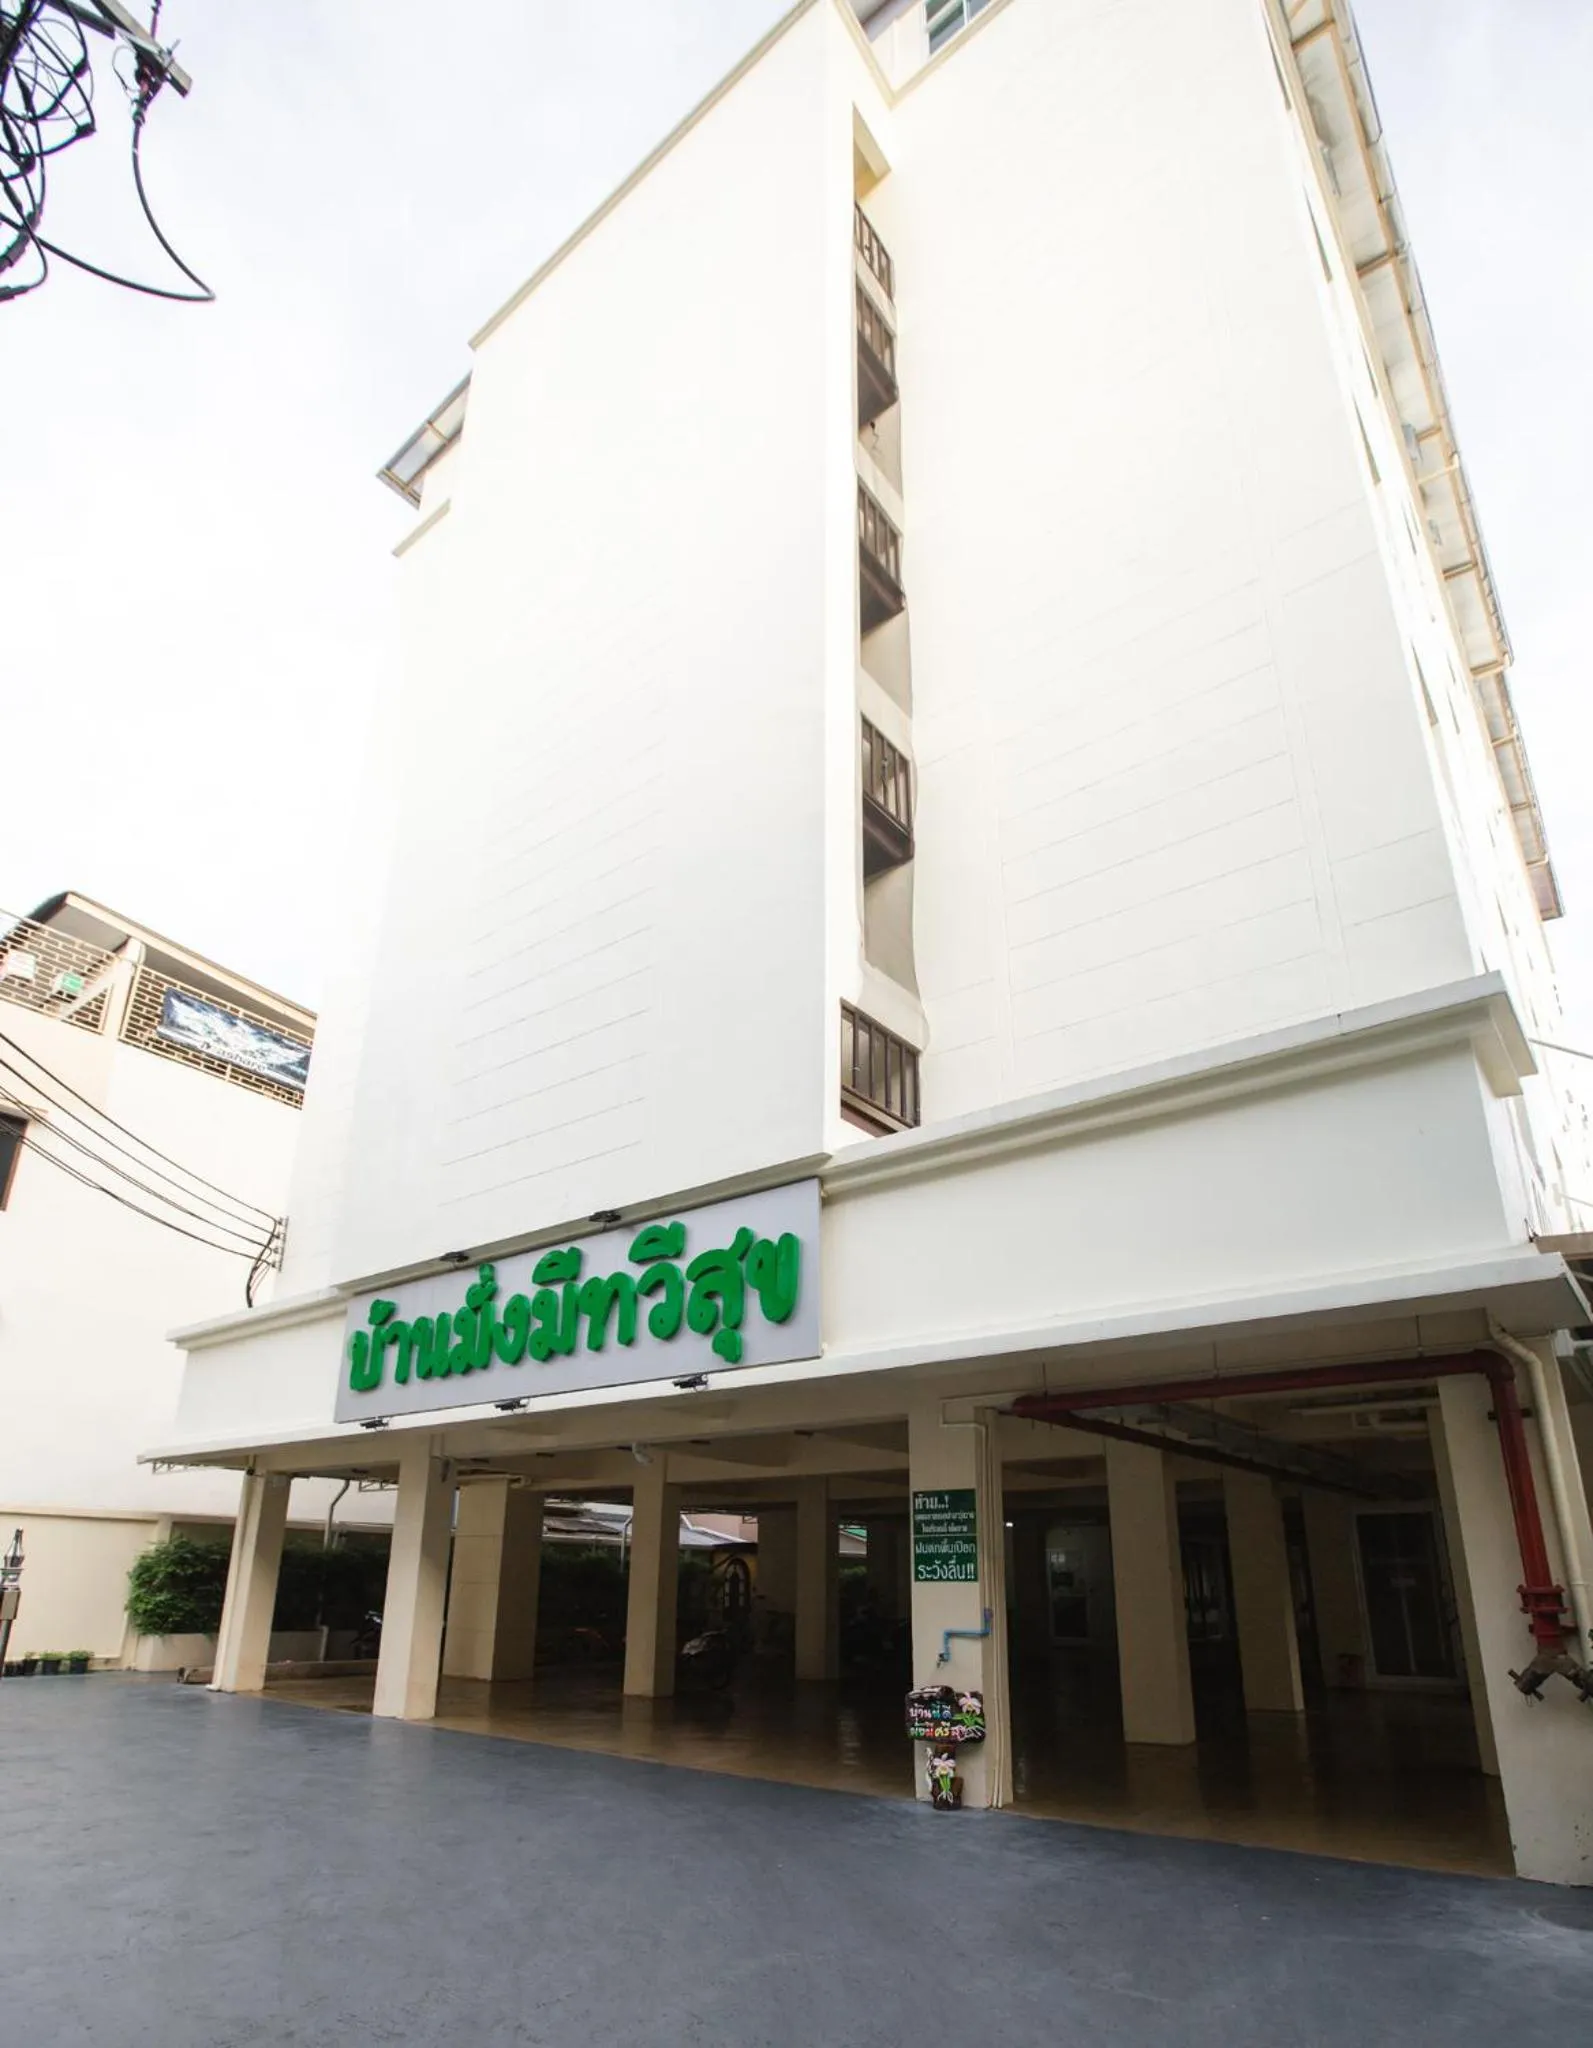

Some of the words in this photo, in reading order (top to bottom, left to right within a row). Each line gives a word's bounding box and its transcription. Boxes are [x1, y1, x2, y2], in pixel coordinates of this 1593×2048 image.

[349, 1221, 801, 1393] บ้านมั่งมีทวีสุข
[918, 1555, 975, 1580] ระวังลื่น!!
